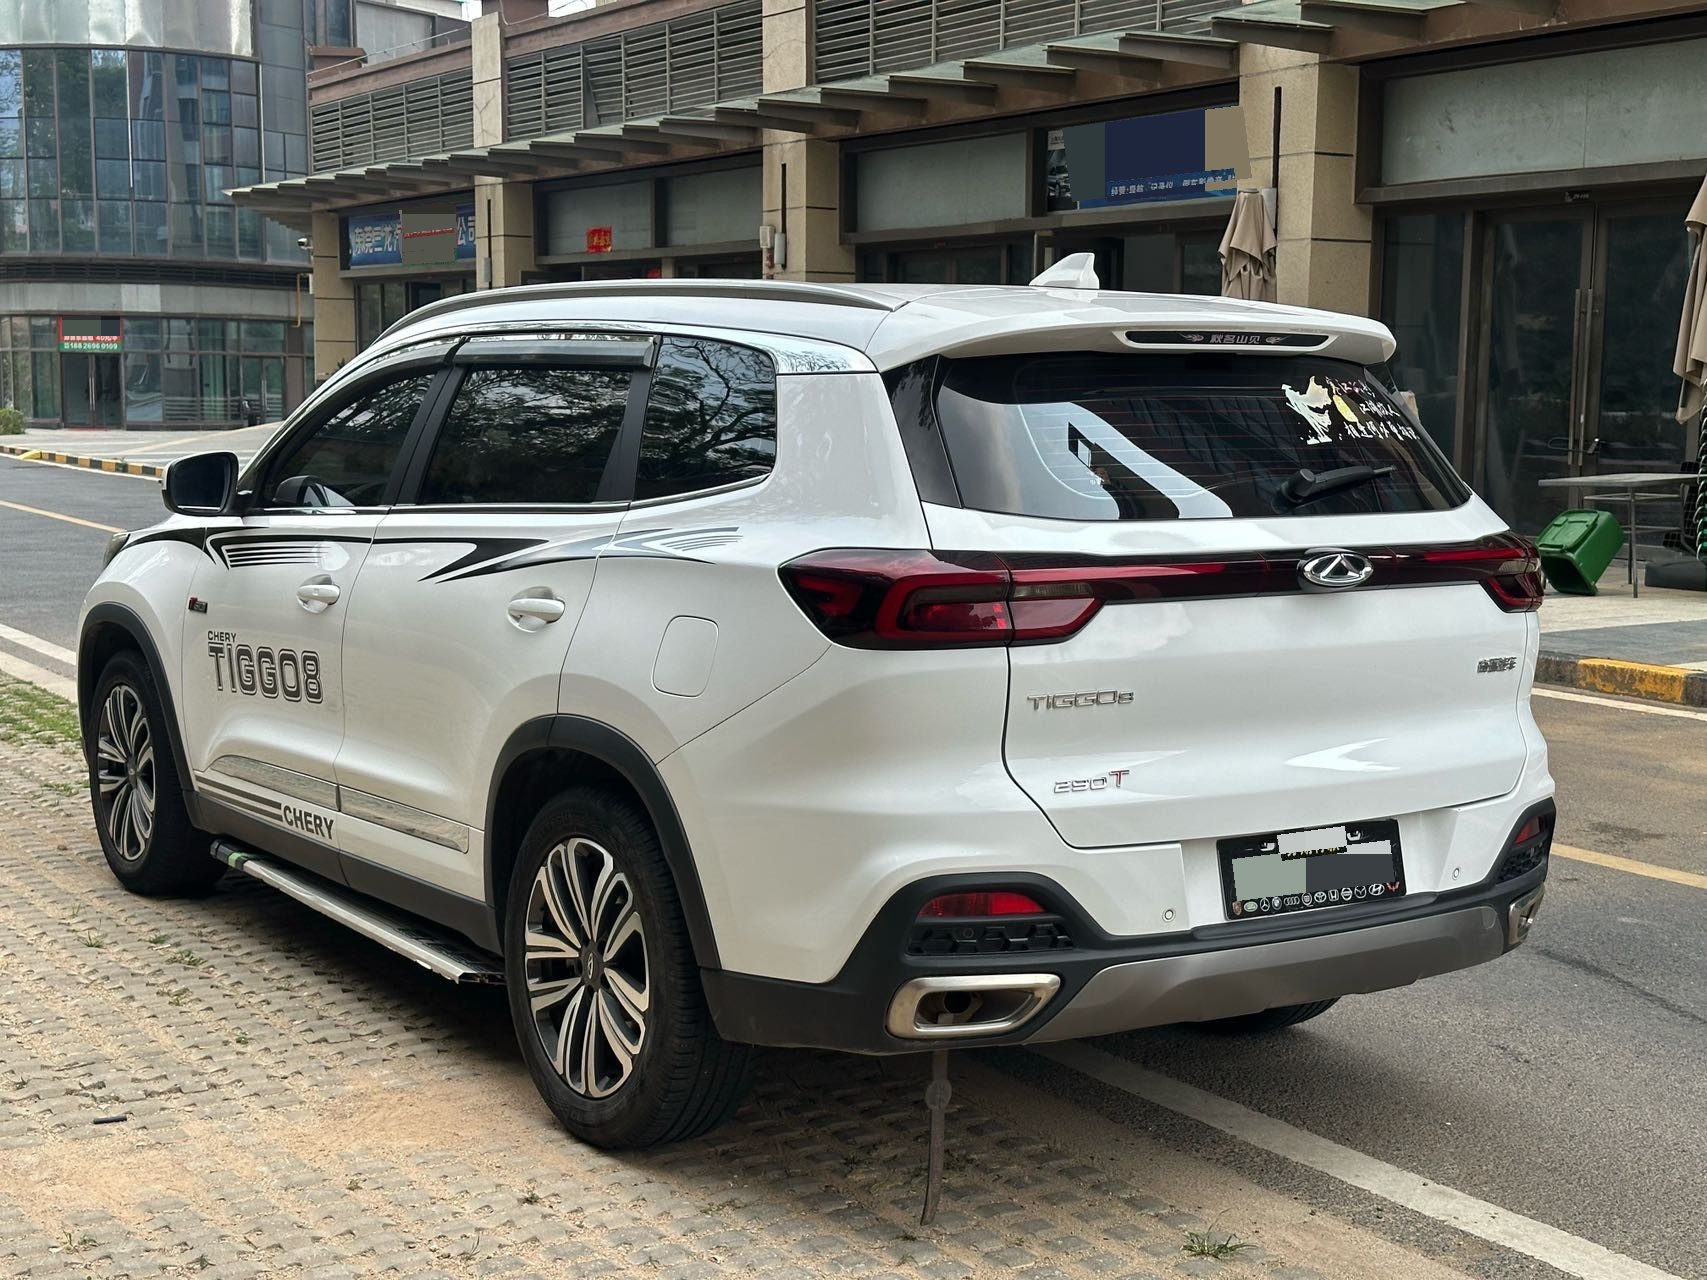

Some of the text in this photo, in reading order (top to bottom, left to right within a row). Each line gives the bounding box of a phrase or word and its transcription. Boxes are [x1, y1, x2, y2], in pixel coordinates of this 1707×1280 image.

[207, 630, 237, 643] CHERY
[207, 642, 323, 705] TIGGO8
[1027, 689, 1134, 711] TIGGO8
[1053, 768, 1131, 793] 290T
[283, 805, 334, 840] CHERY
